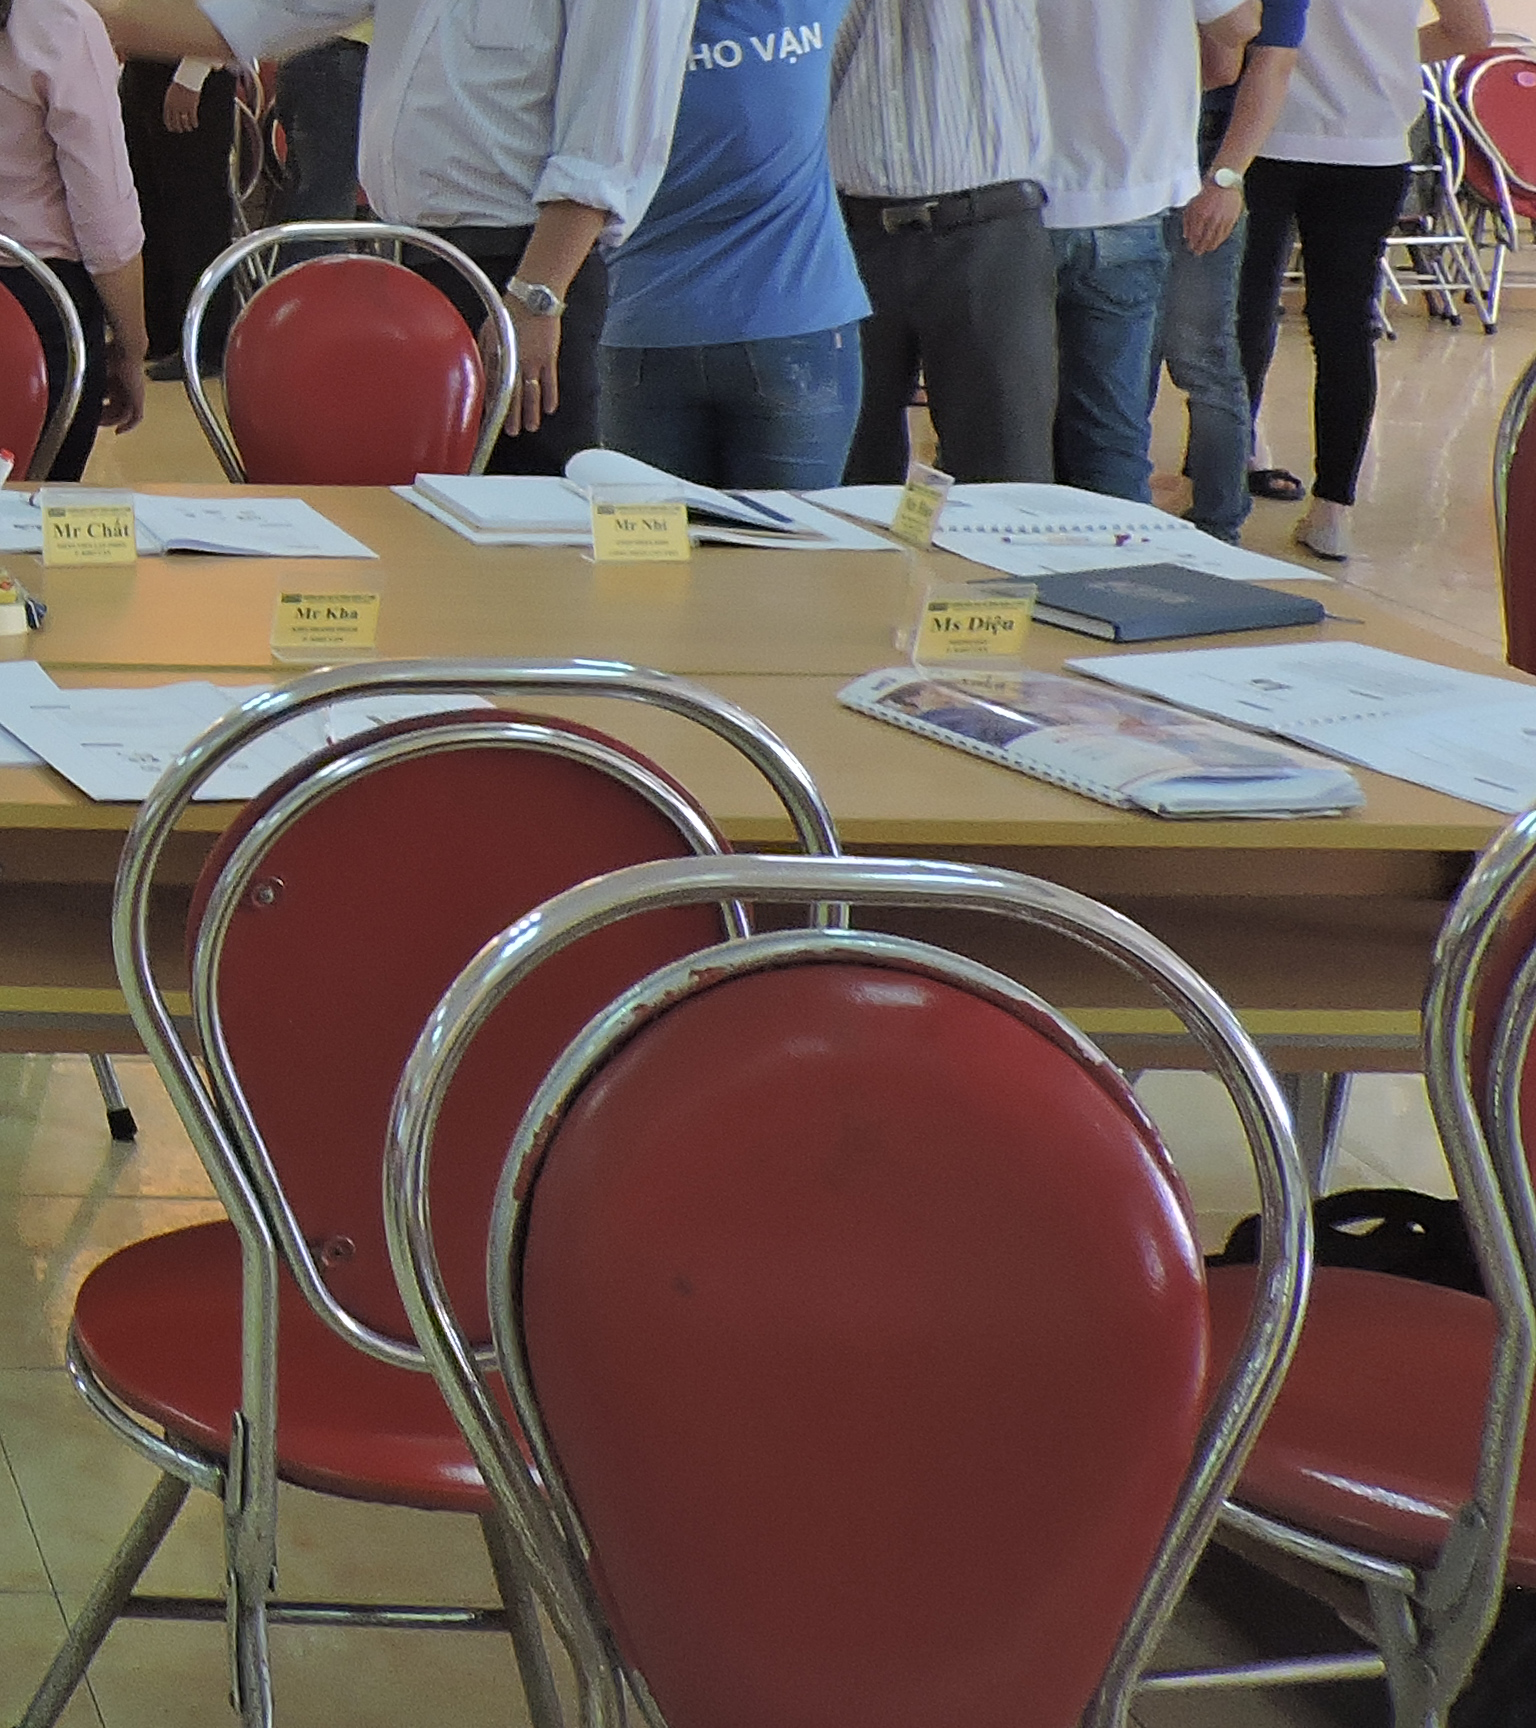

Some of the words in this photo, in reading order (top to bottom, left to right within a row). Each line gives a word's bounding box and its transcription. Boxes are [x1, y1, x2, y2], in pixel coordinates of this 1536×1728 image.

[750, 22, 823, 64] VẬN
[54, 522, 81, 538] Mr
[296, 607, 321, 619] Mr
[931, 616, 961, 632] Ms
